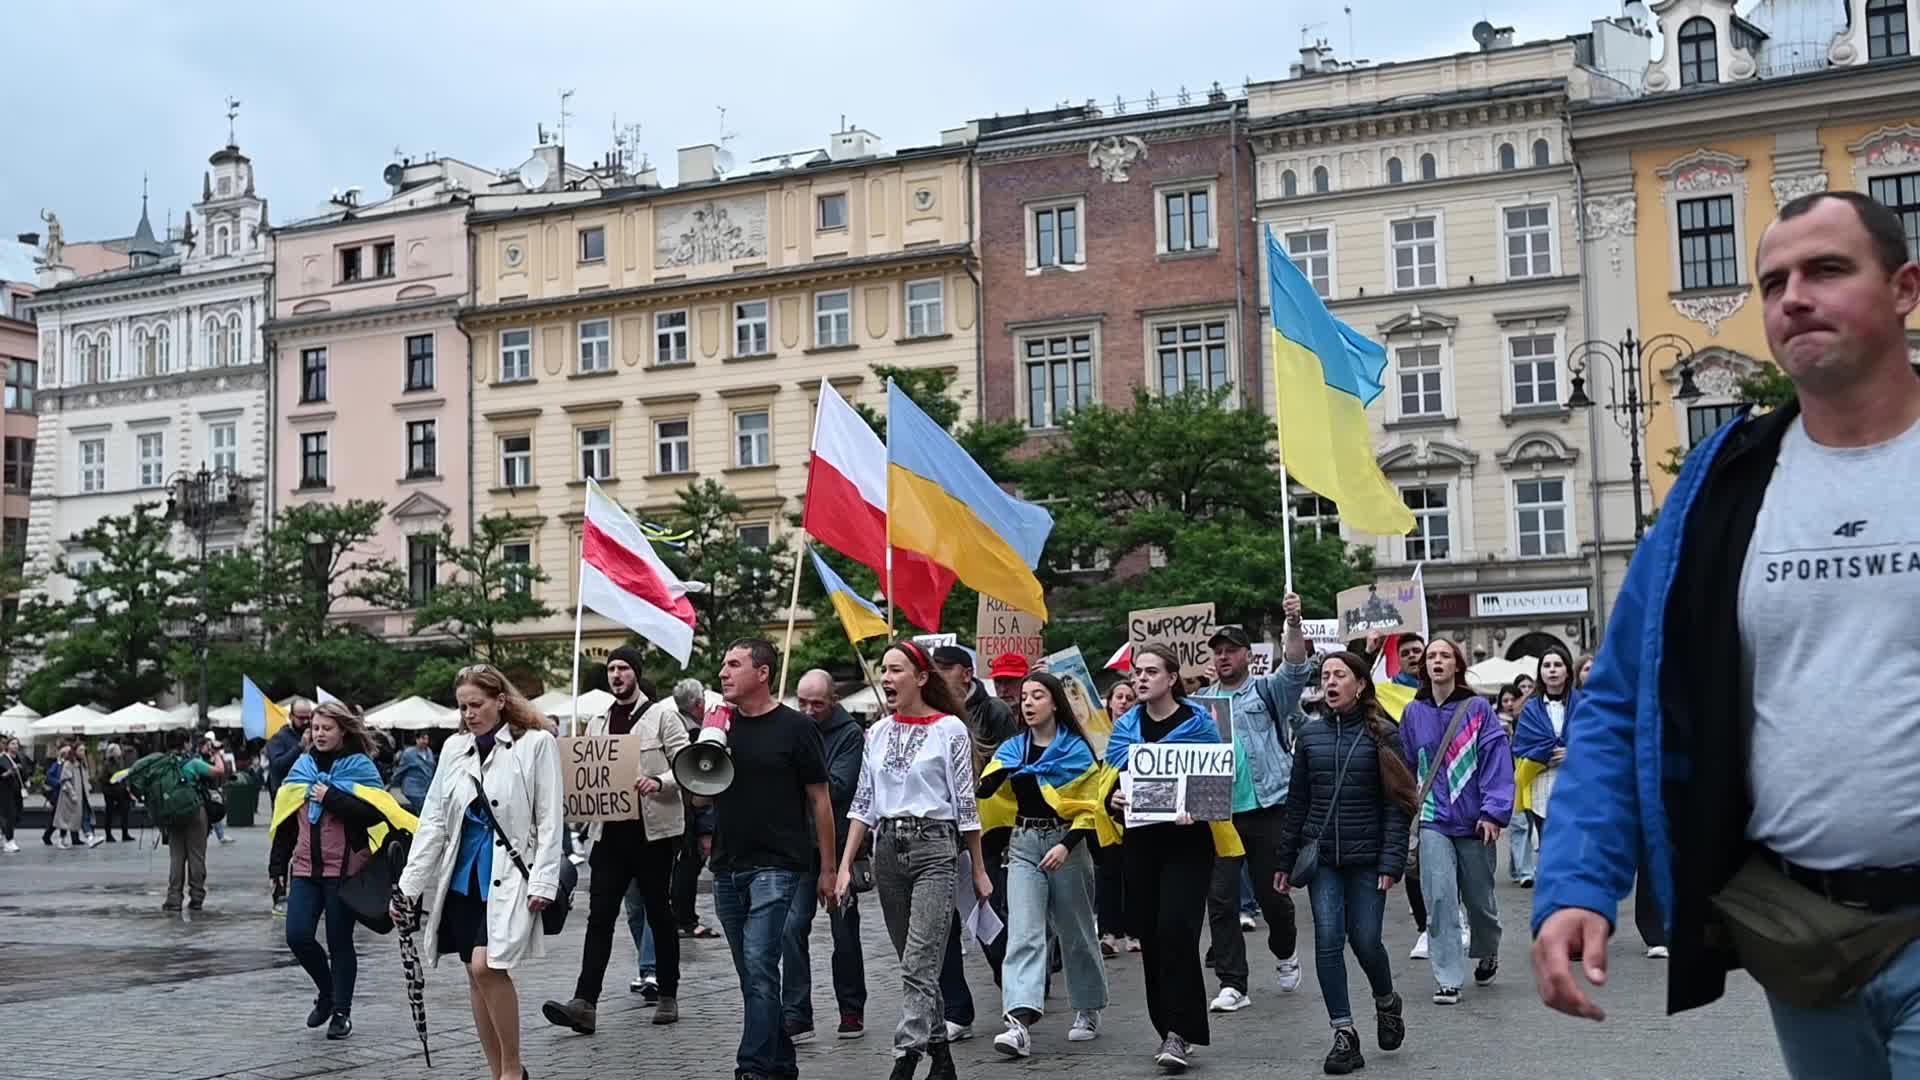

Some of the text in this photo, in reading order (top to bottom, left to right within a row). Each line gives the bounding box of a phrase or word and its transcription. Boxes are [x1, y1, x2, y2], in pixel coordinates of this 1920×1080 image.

[993, 616, 1020, 635] IS A
[1303, 624, 1326, 636] SSIA
[977, 636, 1043, 656] TERRORIST
[572, 739, 620, 764] SAVE
[1134, 747, 1234, 776] OLENIVKA
[575, 766, 610, 791] OUR
